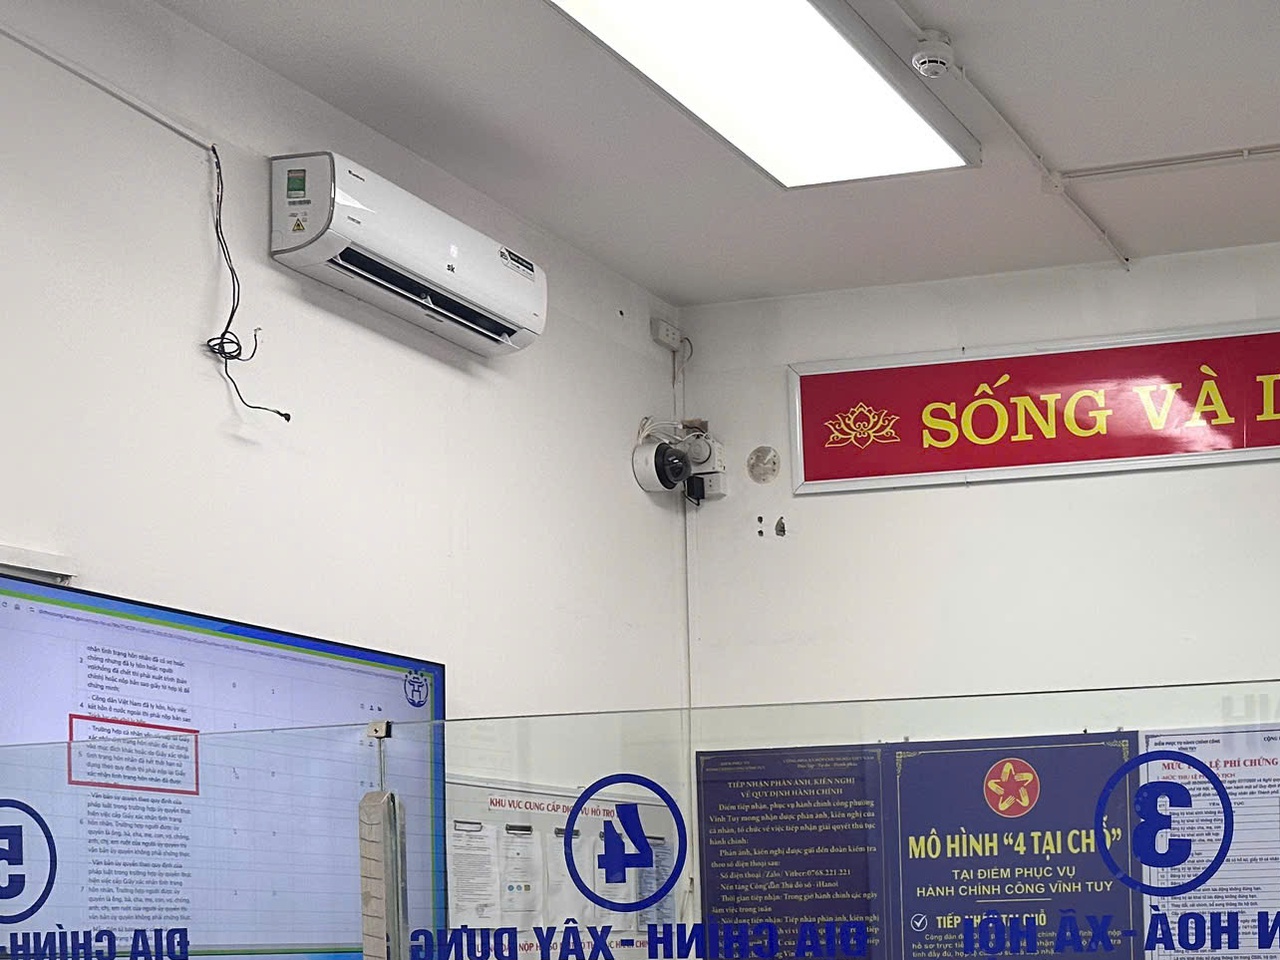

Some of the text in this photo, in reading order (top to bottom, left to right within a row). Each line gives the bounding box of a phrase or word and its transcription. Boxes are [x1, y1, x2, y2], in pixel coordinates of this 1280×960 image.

[922, 374, 1113, 449] SỐNG
[1132, 365, 1231, 430] VÀ
[1162, 760, 1185, 771] MỨC
[1209, 759, 1221, 770] LỆ
[1223, 756, 1241, 768] PHÍ
[1243, 755, 1278, 768] CHỨNG
[490, 798, 506, 808] KHU
[524, 800, 544, 811] CUNG
[546, 799, 560, 813] CẤP
[908, 827, 942, 860] MÔ
[946, 826, 998, 858] HÌNH
[1030, 830, 1062, 861] TẠI
[952, 869, 973, 882] TẠI
[1015, 867, 1053, 880] PHỤC
[1057, 865, 1076, 879] VỤ
[917, 880, 1113, 897] HÀNH CHÍNH CÔNG VĨNH TUY
[936, 912, 961, 929] TIẾP
